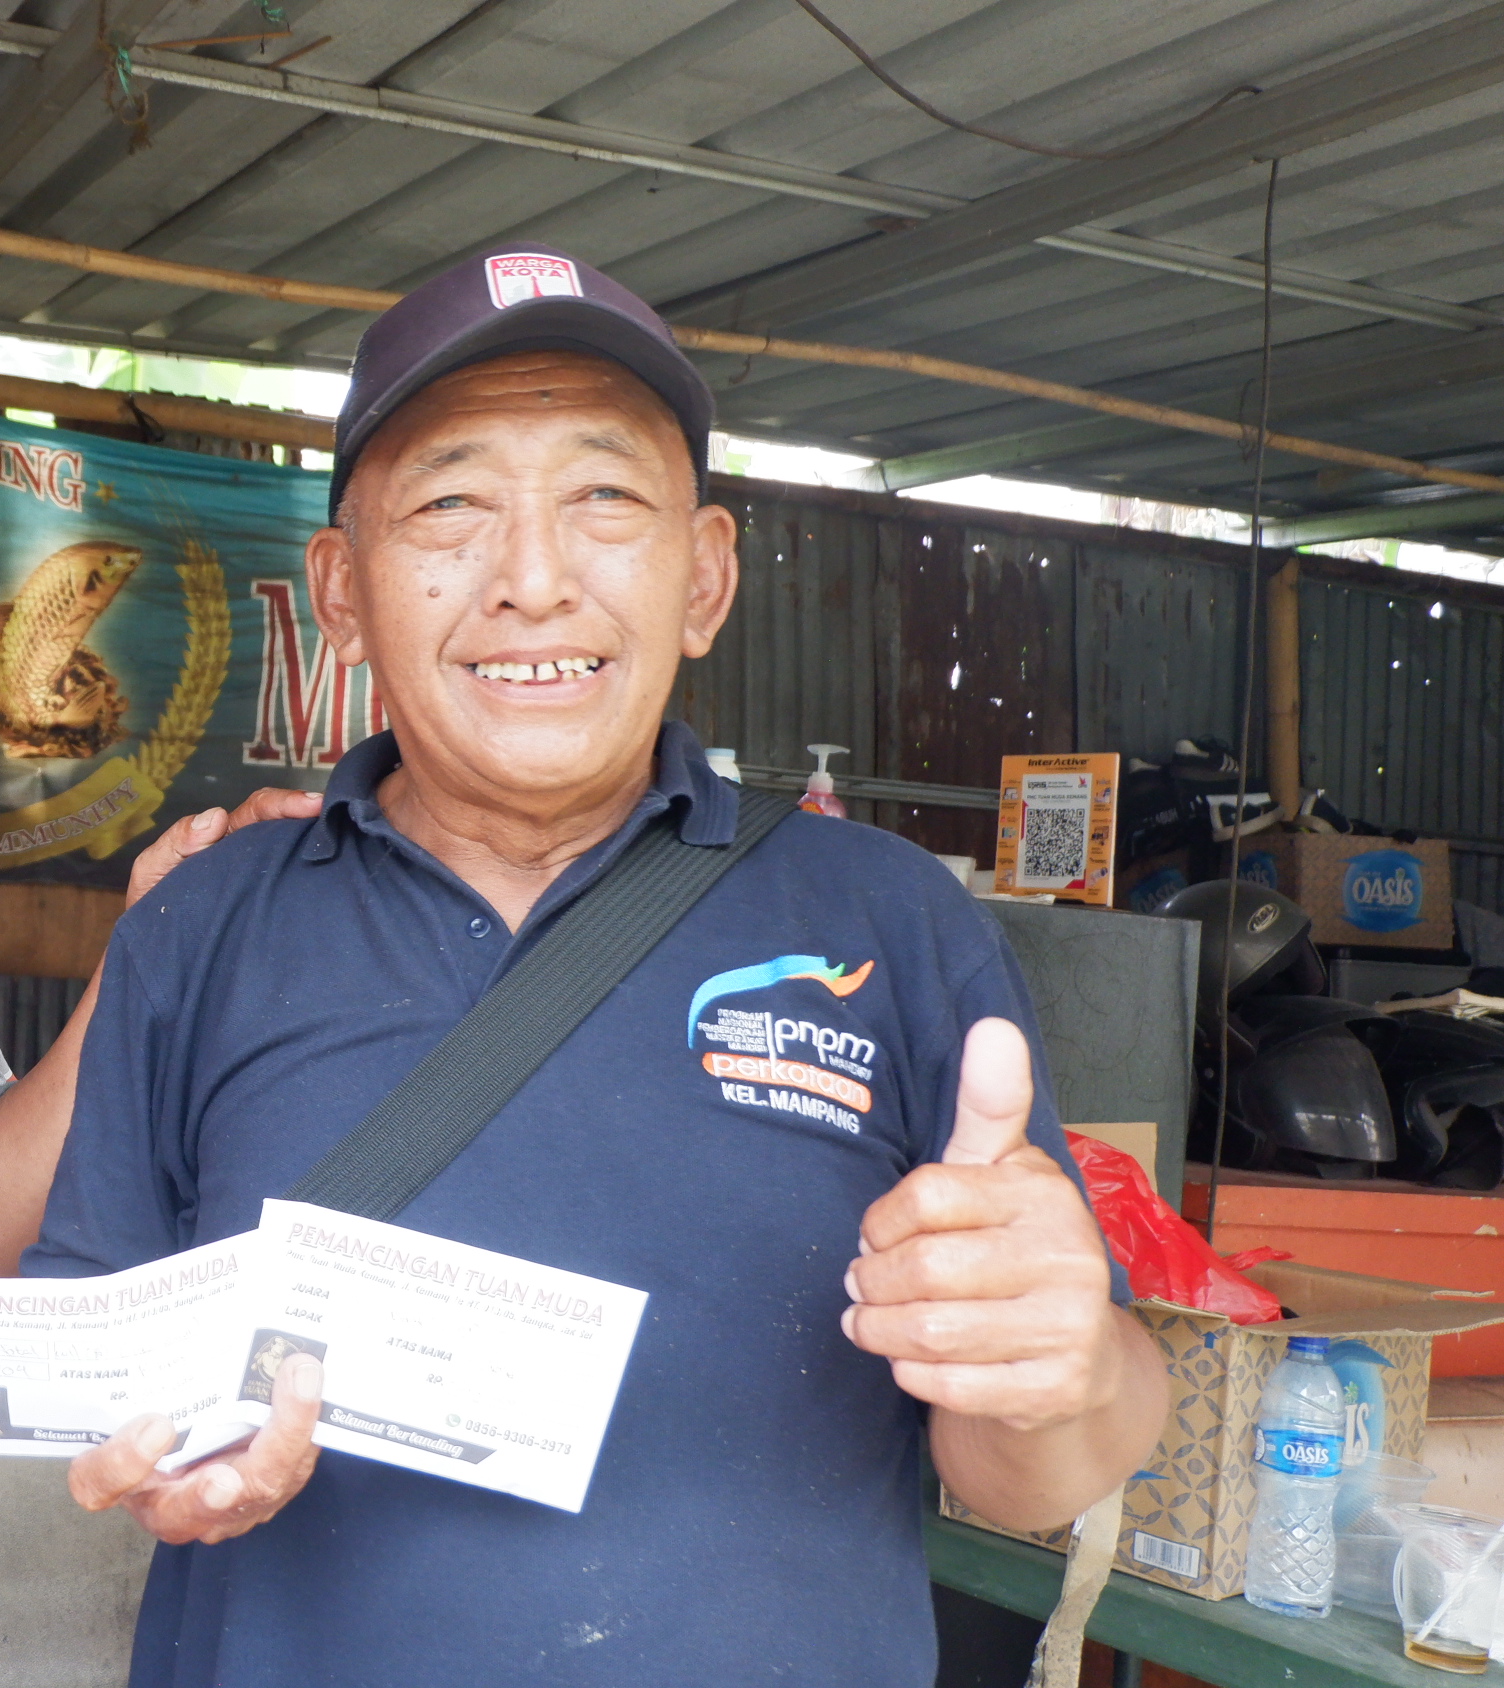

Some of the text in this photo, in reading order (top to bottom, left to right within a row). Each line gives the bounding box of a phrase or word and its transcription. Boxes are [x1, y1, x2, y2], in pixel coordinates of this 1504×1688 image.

[495, 258, 566, 270] WARGA
[501, 267, 565, 278] KOTA
[1027, 758, 1088, 767] InterActive
[1352, 868, 1414, 906] OASIS
[717, 1008, 764, 1020] PROGRAM
[717, 1018, 764, 1030] NASIONAL
[774, 1017, 876, 1065] pnpm
[711, 1052, 867, 1107] perkotaan
[115, 1273, 173, 1311] TUAN
[179, 1253, 239, 1292] MUDA
[285, 1222, 603, 1327] PEMANCINGAN TUAN MUDA
[291, 1282, 331, 1300] JUARA
[285, 1306, 324, 1323] LAPAK
[386, 1336, 453, 1362] ATAS NAMA
[59, 1368, 129, 1379] ATAS NAMA
[110, 1391, 129, 1401] RP.
[33, 1428, 87, 1442] Selamat
[330, 1408, 464, 1459] Selamat Bertanding
[464, 1419, 572, 1455] 0856-9306-2978
[1282, 1443, 1330, 1465] OASIS
